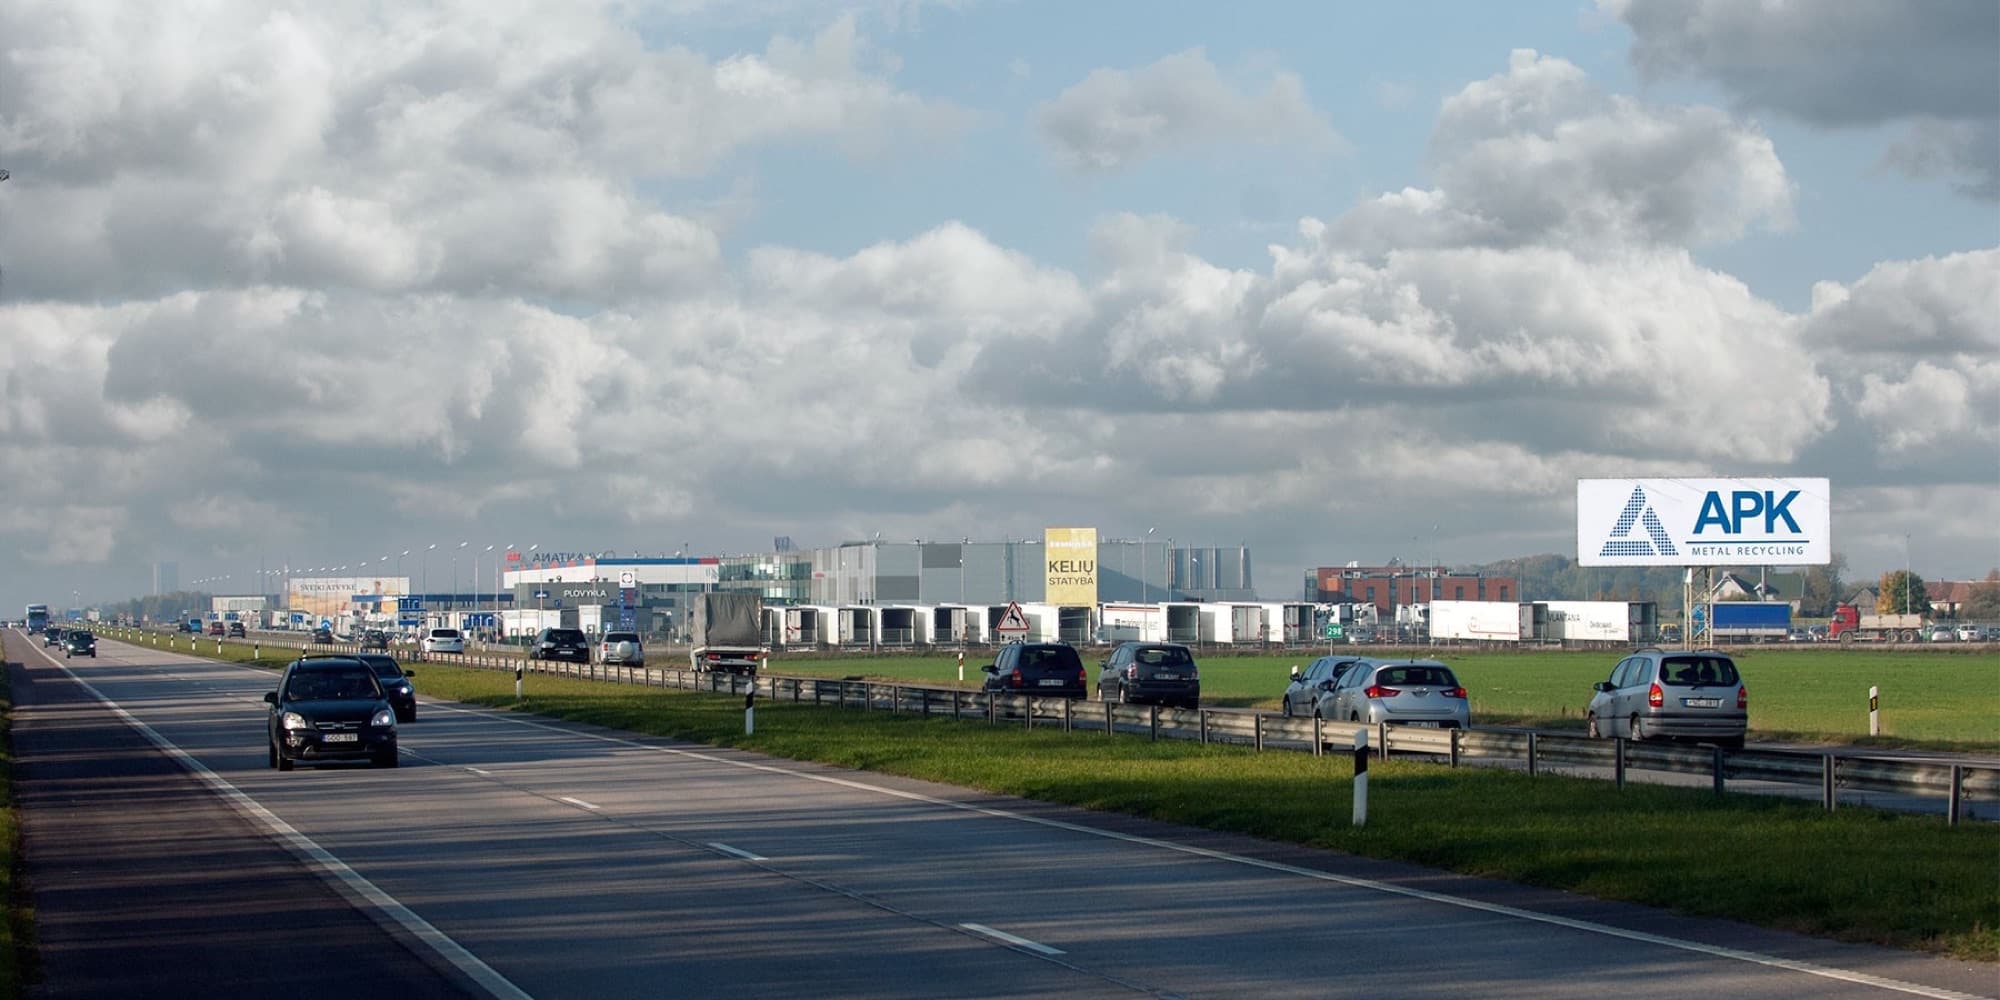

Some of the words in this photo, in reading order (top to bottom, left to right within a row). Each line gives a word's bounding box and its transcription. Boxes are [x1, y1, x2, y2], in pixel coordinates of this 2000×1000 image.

[1692, 490, 1802, 534] APK
[1692, 547, 1732, 556] METAL
[1738, 546, 1804, 556] RECYCLING
[1048, 560, 1094, 575] KELIŲ
[1048, 577, 1094, 585] STATYBA
[563, 589, 607, 598] PLOVYKLA
[1328, 627, 1341, 635] 298
